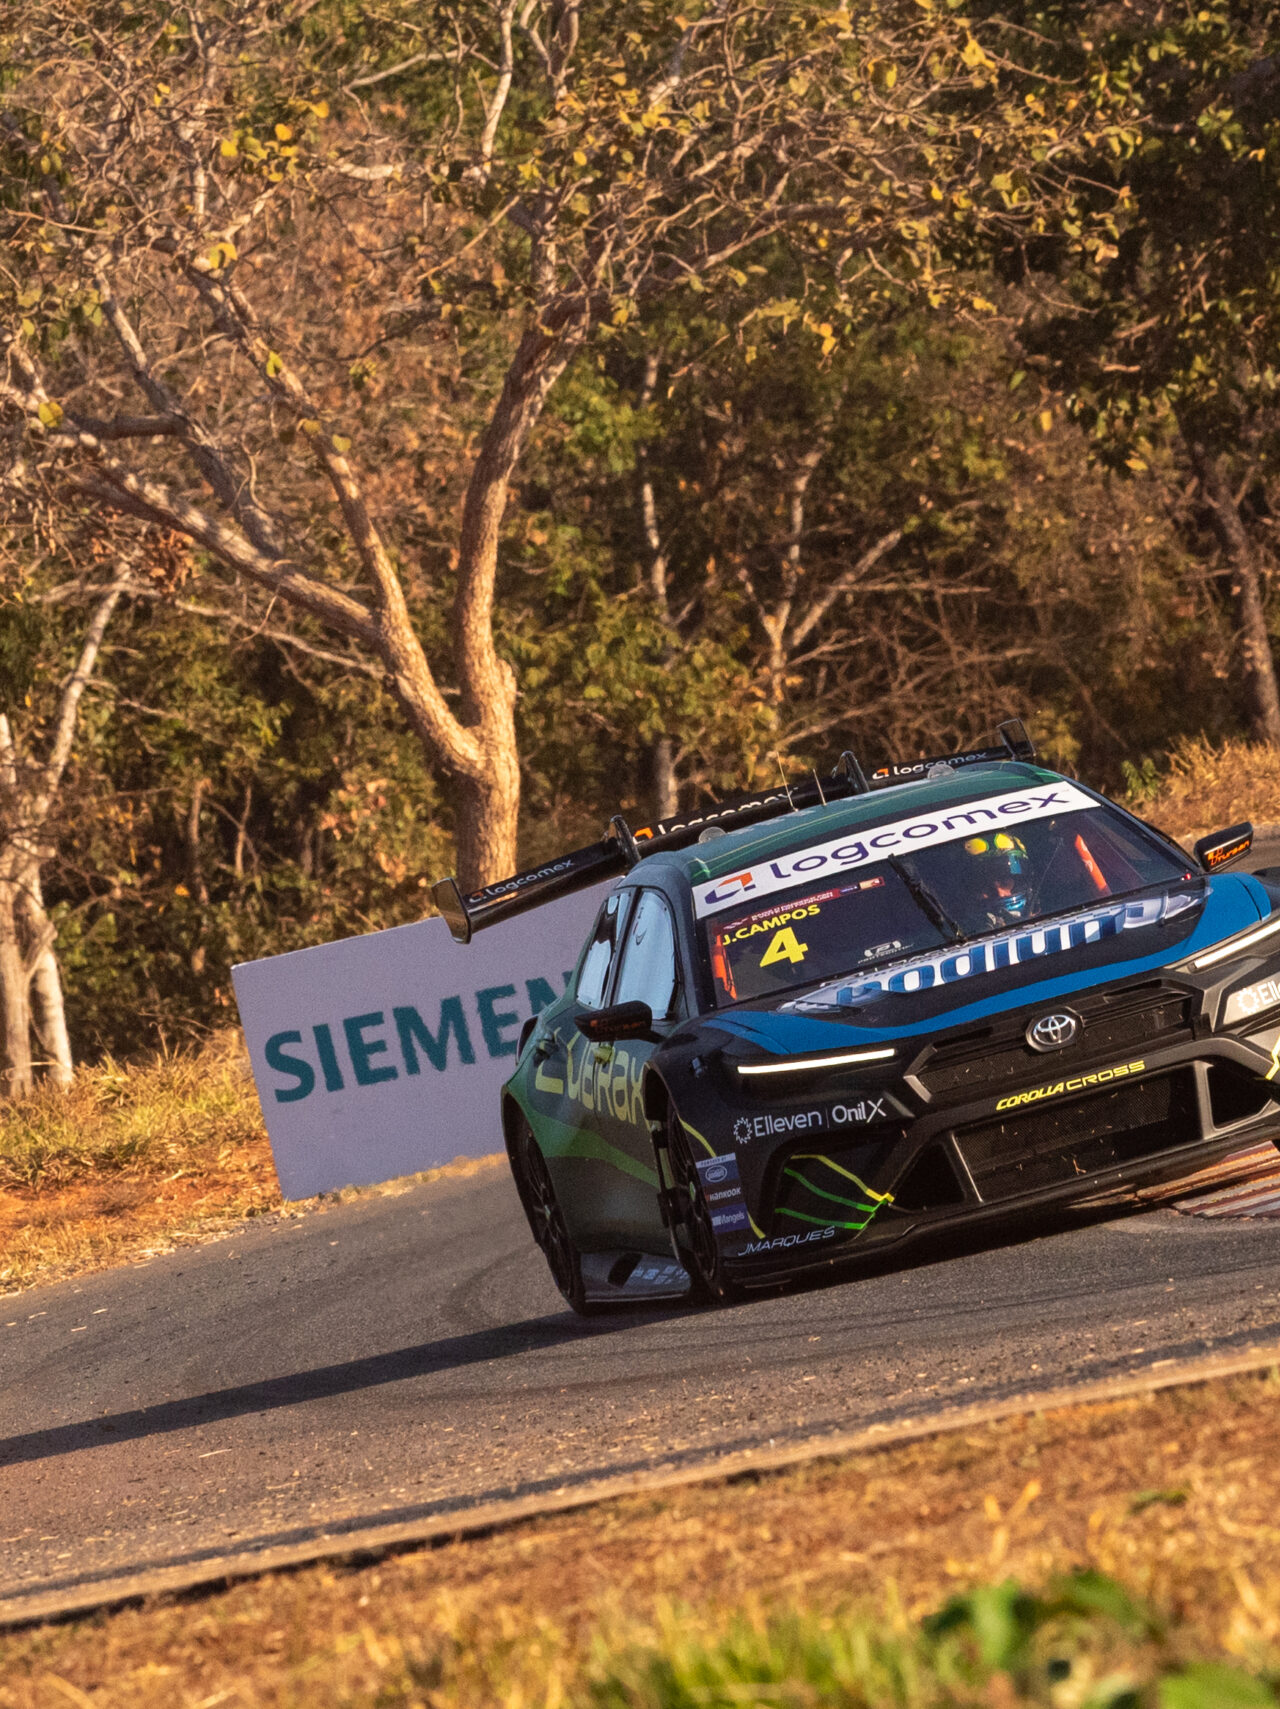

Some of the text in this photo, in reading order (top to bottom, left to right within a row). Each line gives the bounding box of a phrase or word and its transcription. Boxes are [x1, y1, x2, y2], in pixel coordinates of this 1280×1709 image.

[893, 752, 987, 775] logcomex
[770, 792, 1070, 878] logcomex
[486, 859, 574, 896] logcomex
[722, 904, 821, 945] J.CAMPOS
[760, 926, 808, 968] 4
[996, 1060, 1145, 1110] COROLLA CROSS
[753, 1111, 822, 1137] Elleven
[738, 1226, 835, 1256] JMARQUES
